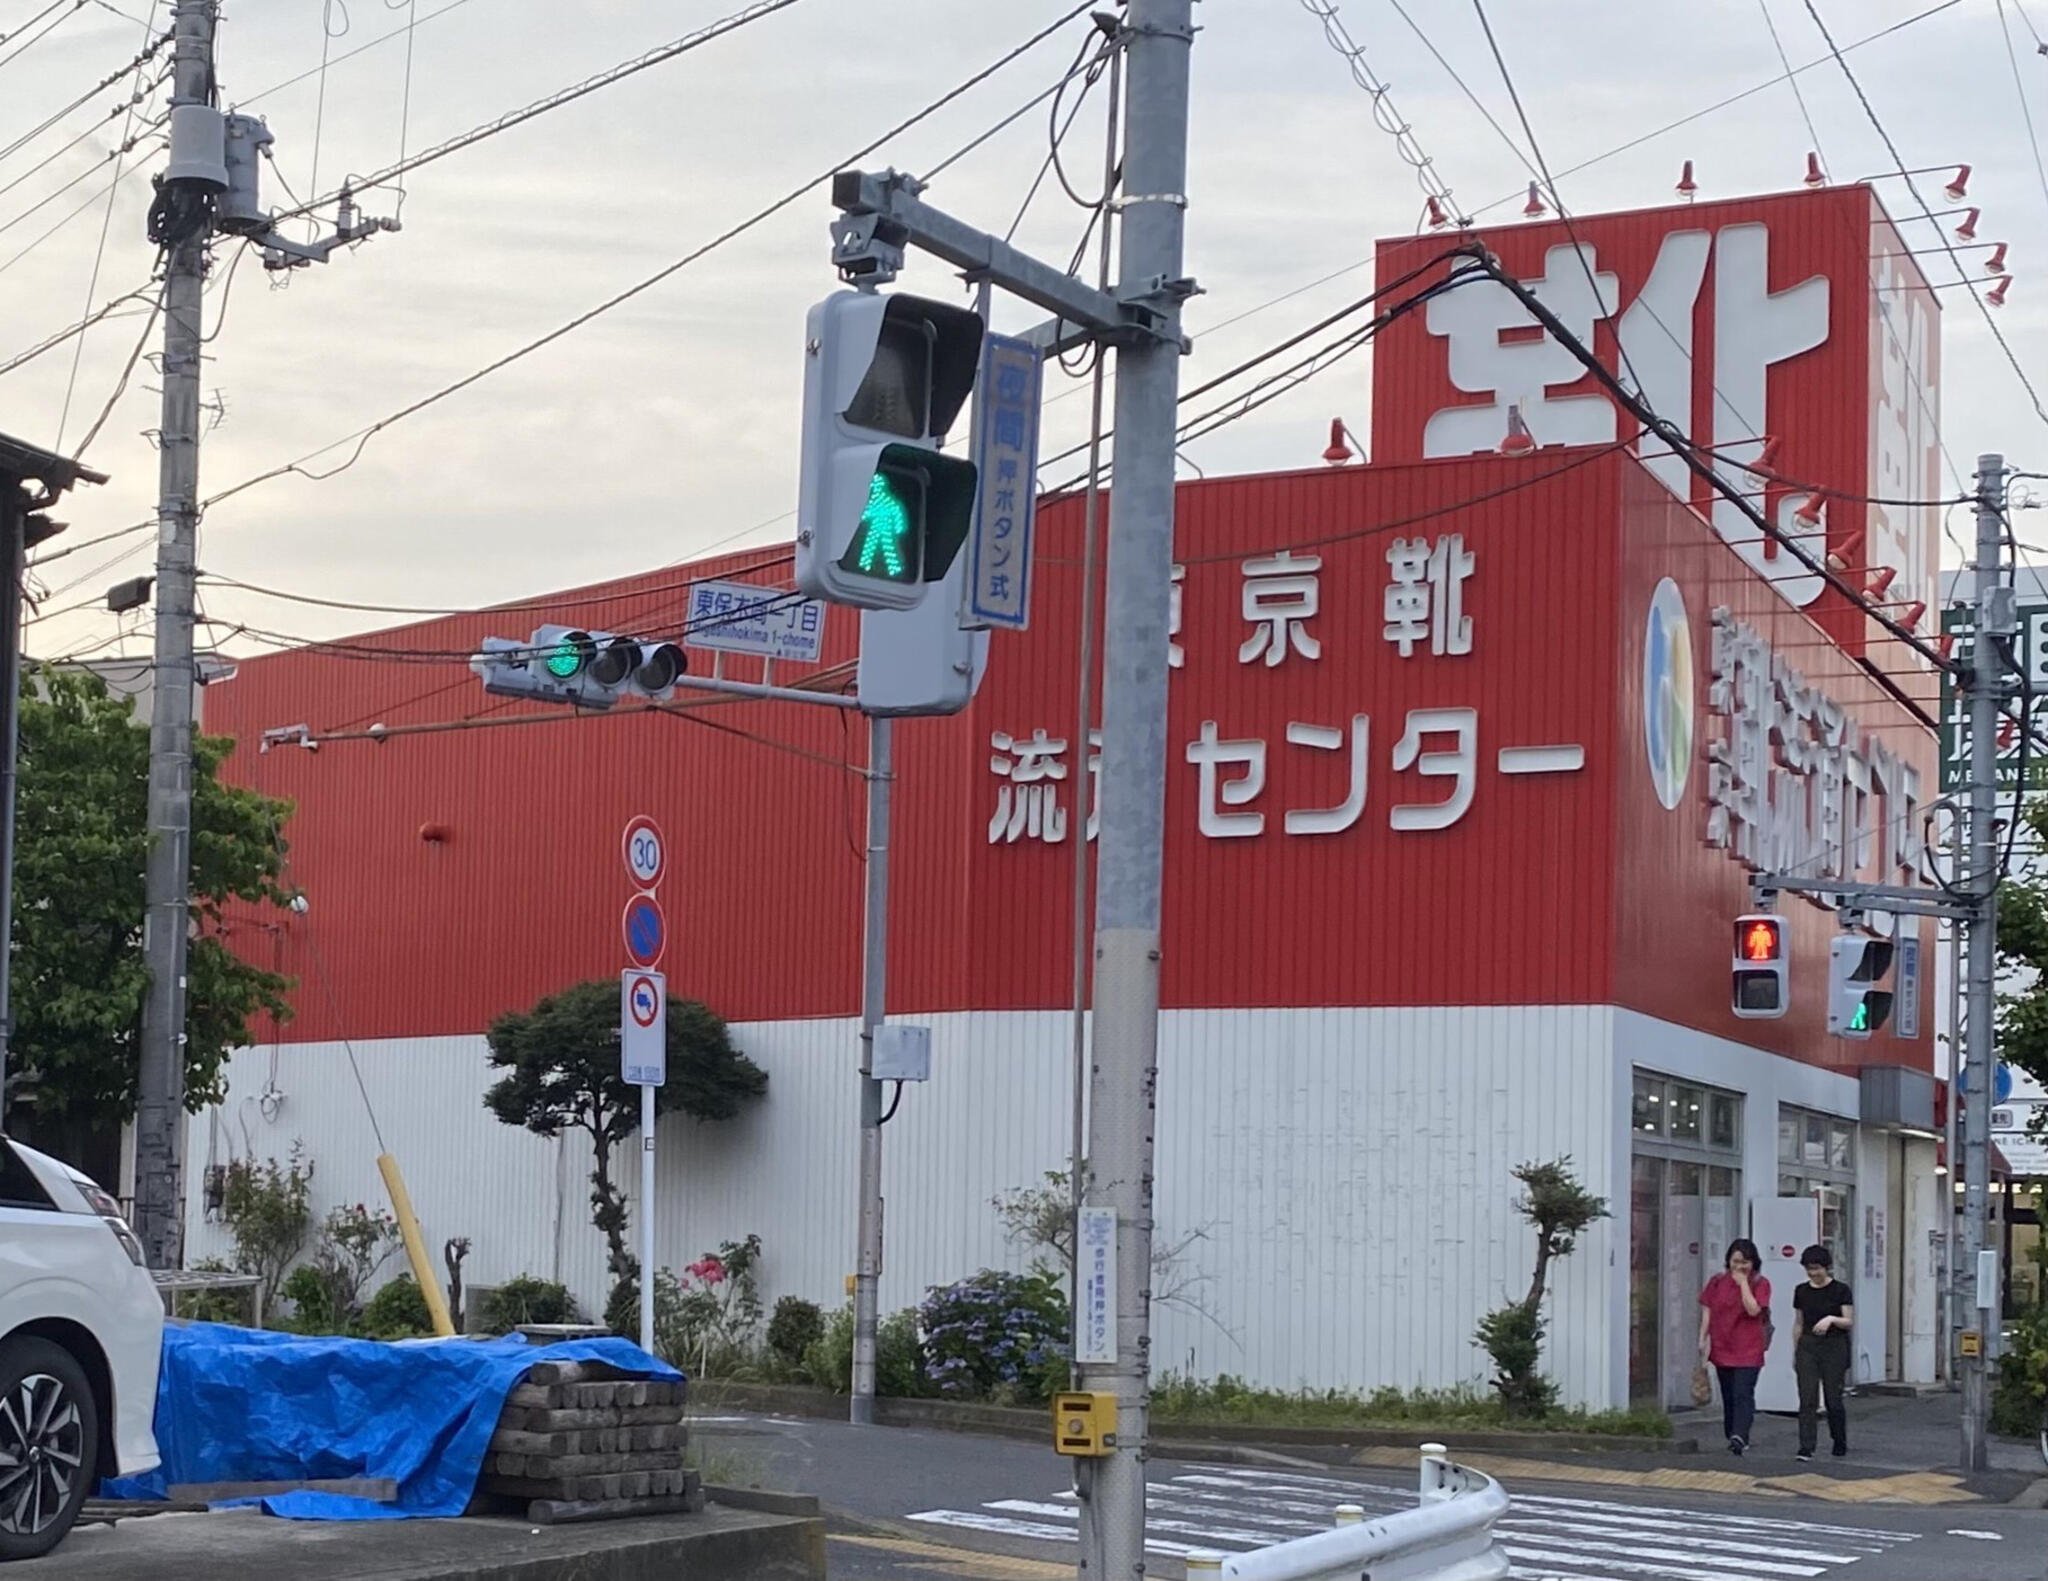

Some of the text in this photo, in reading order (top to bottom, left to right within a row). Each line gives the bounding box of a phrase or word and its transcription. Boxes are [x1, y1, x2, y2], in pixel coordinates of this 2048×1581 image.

[1168, 533, 1475, 668] 京靴
[988, 706, 1585, 844] 流センター
[1948, 767, 2030, 784] MEANE
[634, 837, 658, 871] 30
